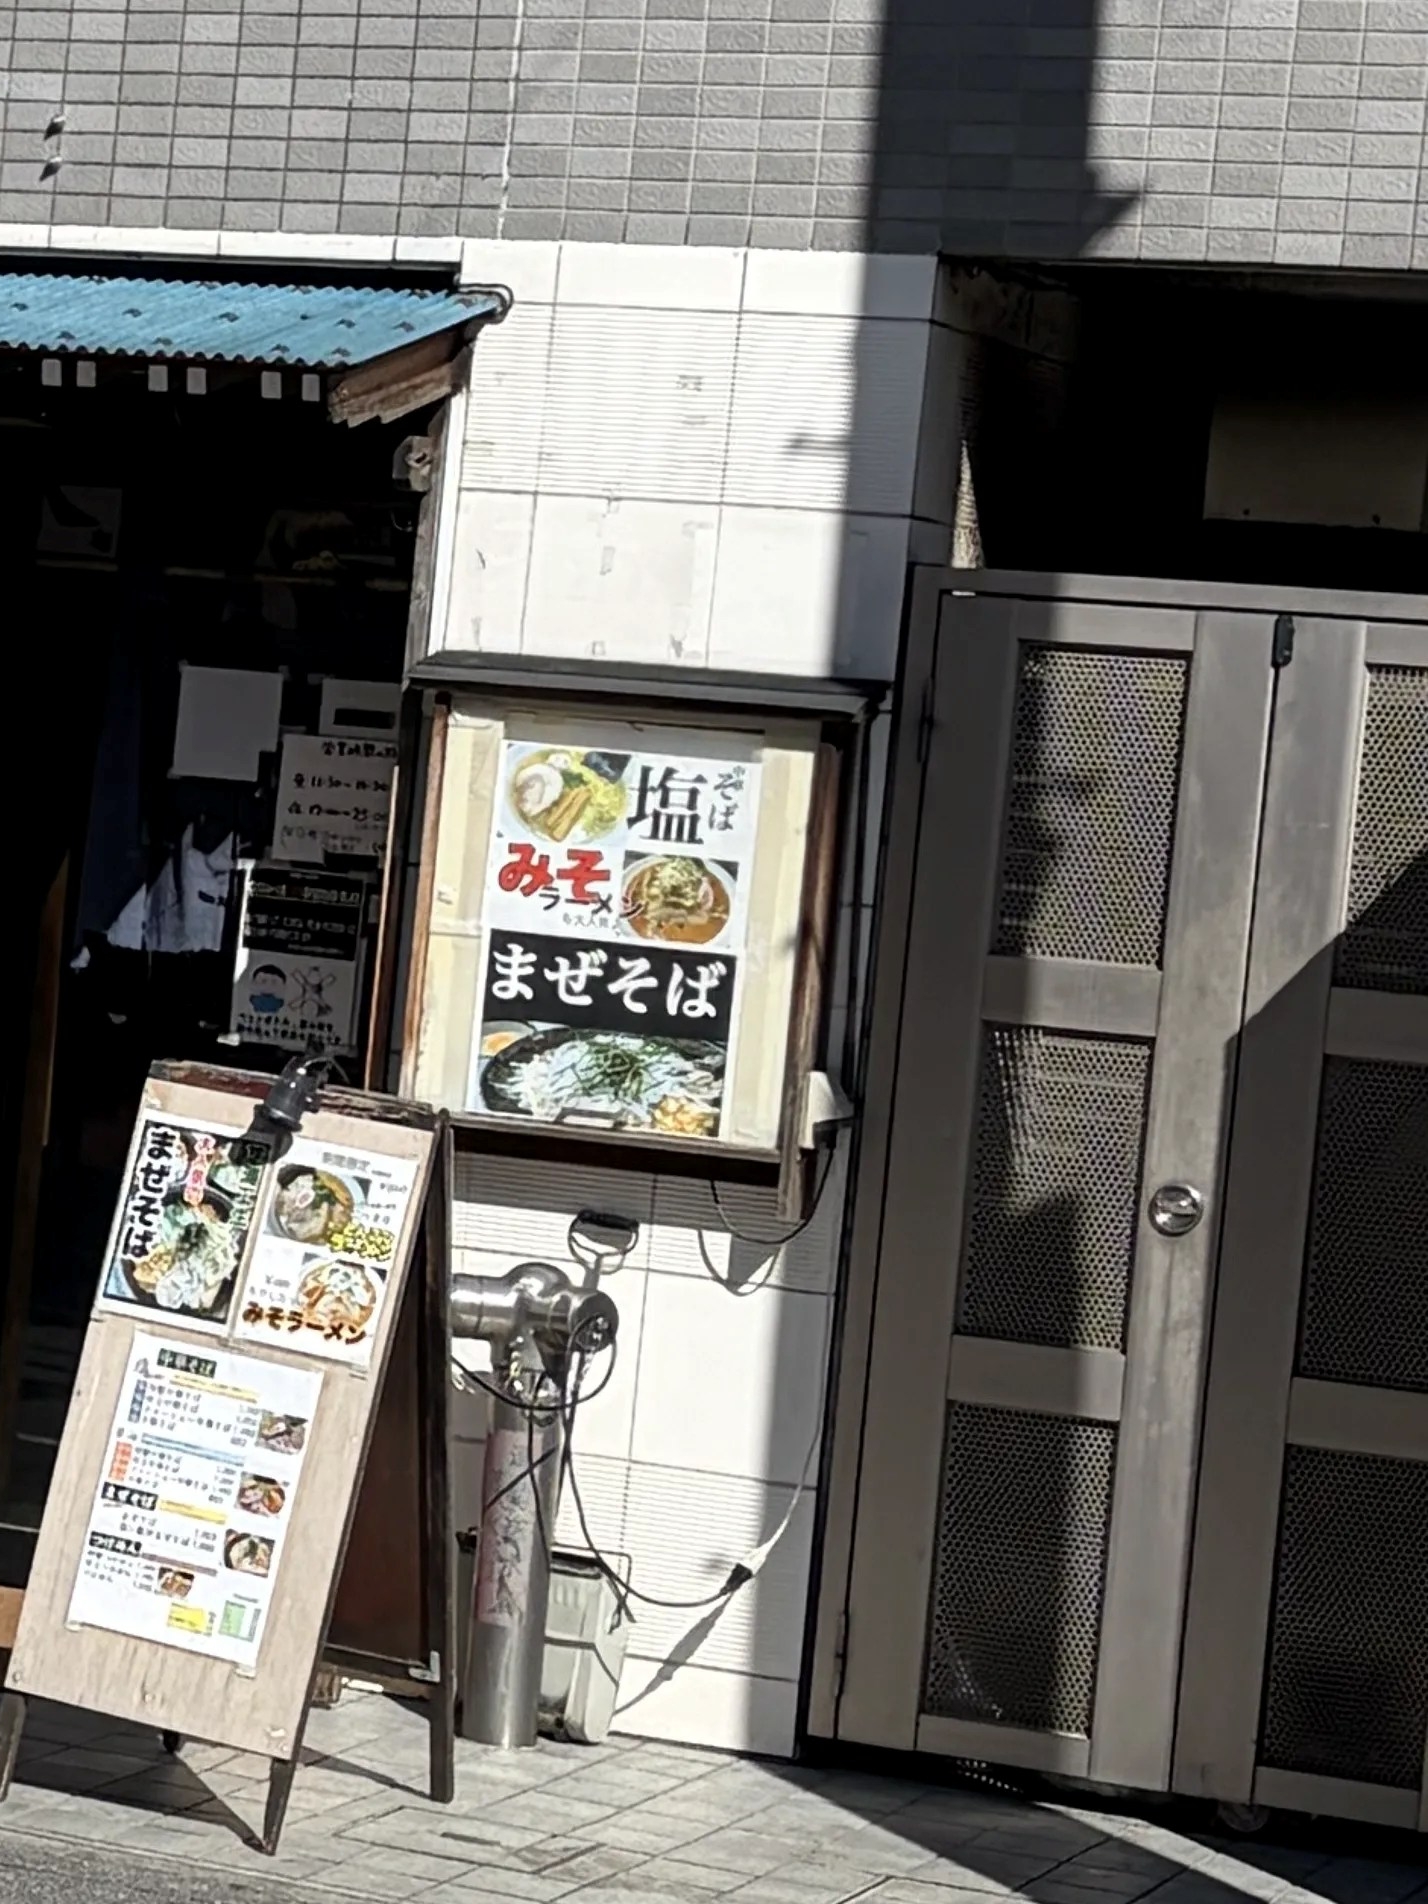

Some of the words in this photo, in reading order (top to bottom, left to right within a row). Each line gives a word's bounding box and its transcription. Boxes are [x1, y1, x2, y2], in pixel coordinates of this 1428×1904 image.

[627, 765, 708, 845] 塩
[498, 842, 611, 901] みそ
[538, 886, 646, 919] ラーメン
[490, 942, 728, 1019] まぜそば
[122, 1126, 177, 1260] まぜそば
[242, 1300, 367, 1345] みそラーメン
